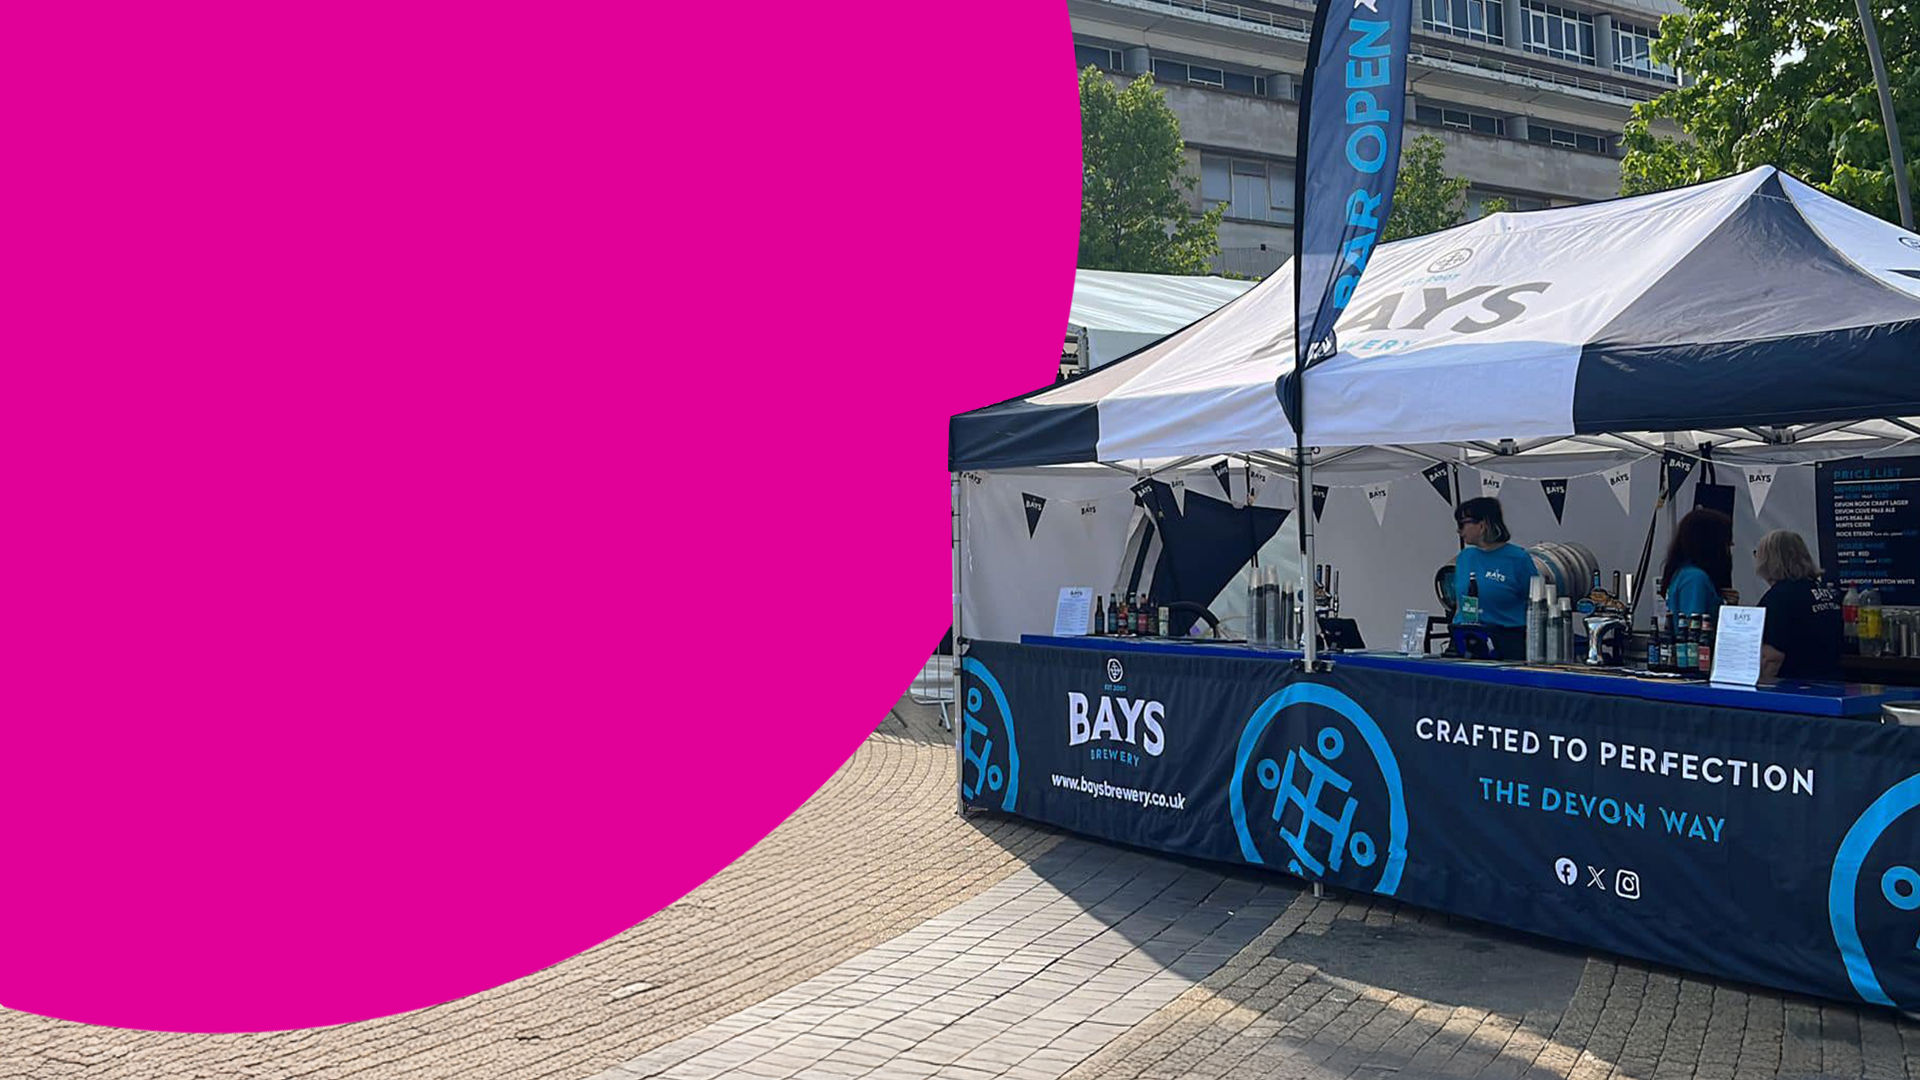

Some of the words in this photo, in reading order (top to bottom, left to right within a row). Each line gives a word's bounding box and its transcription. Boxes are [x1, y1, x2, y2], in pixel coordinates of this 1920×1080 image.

[1345, 18, 1391, 174] OPEN
[1333, 188, 1382, 309] BAR
[1669, 458, 1691, 472] BAYS
[1429, 468, 1448, 482] BAYS
[1749, 473, 1772, 483] BAYS
[1834, 469, 1871, 479] PRICE
[1875, 466, 1902, 478] LIST
[1483, 478, 1500, 489] BAYS
[1609, 473, 1630, 486] BAYS
[1137, 485, 1153, 497] BAYS
[1368, 489, 1387, 500] BAYS
[1546, 485, 1565, 495] BAYS
[1025, 500, 1043, 511] BAYS
[1081, 506, 1096, 515] BAYS
[1485, 570, 1506, 582] BAYS
[1734, 613, 1751, 621] BAYS
[1068, 692, 1165, 757] BAYS
[1090, 749, 1140, 767] BREWERY
[1415, 717, 1540, 754] CRAFTED
[1549, 735, 1588, 762] TO
[1600, 741, 1814, 796] PERFECTION
[1051, 773, 1187, 810] www.baysbrewery.co.uk
[1479, 776, 1531, 808] THE
[1541, 787, 1646, 830] DEVON
[1658, 806, 1726, 843] WAY
